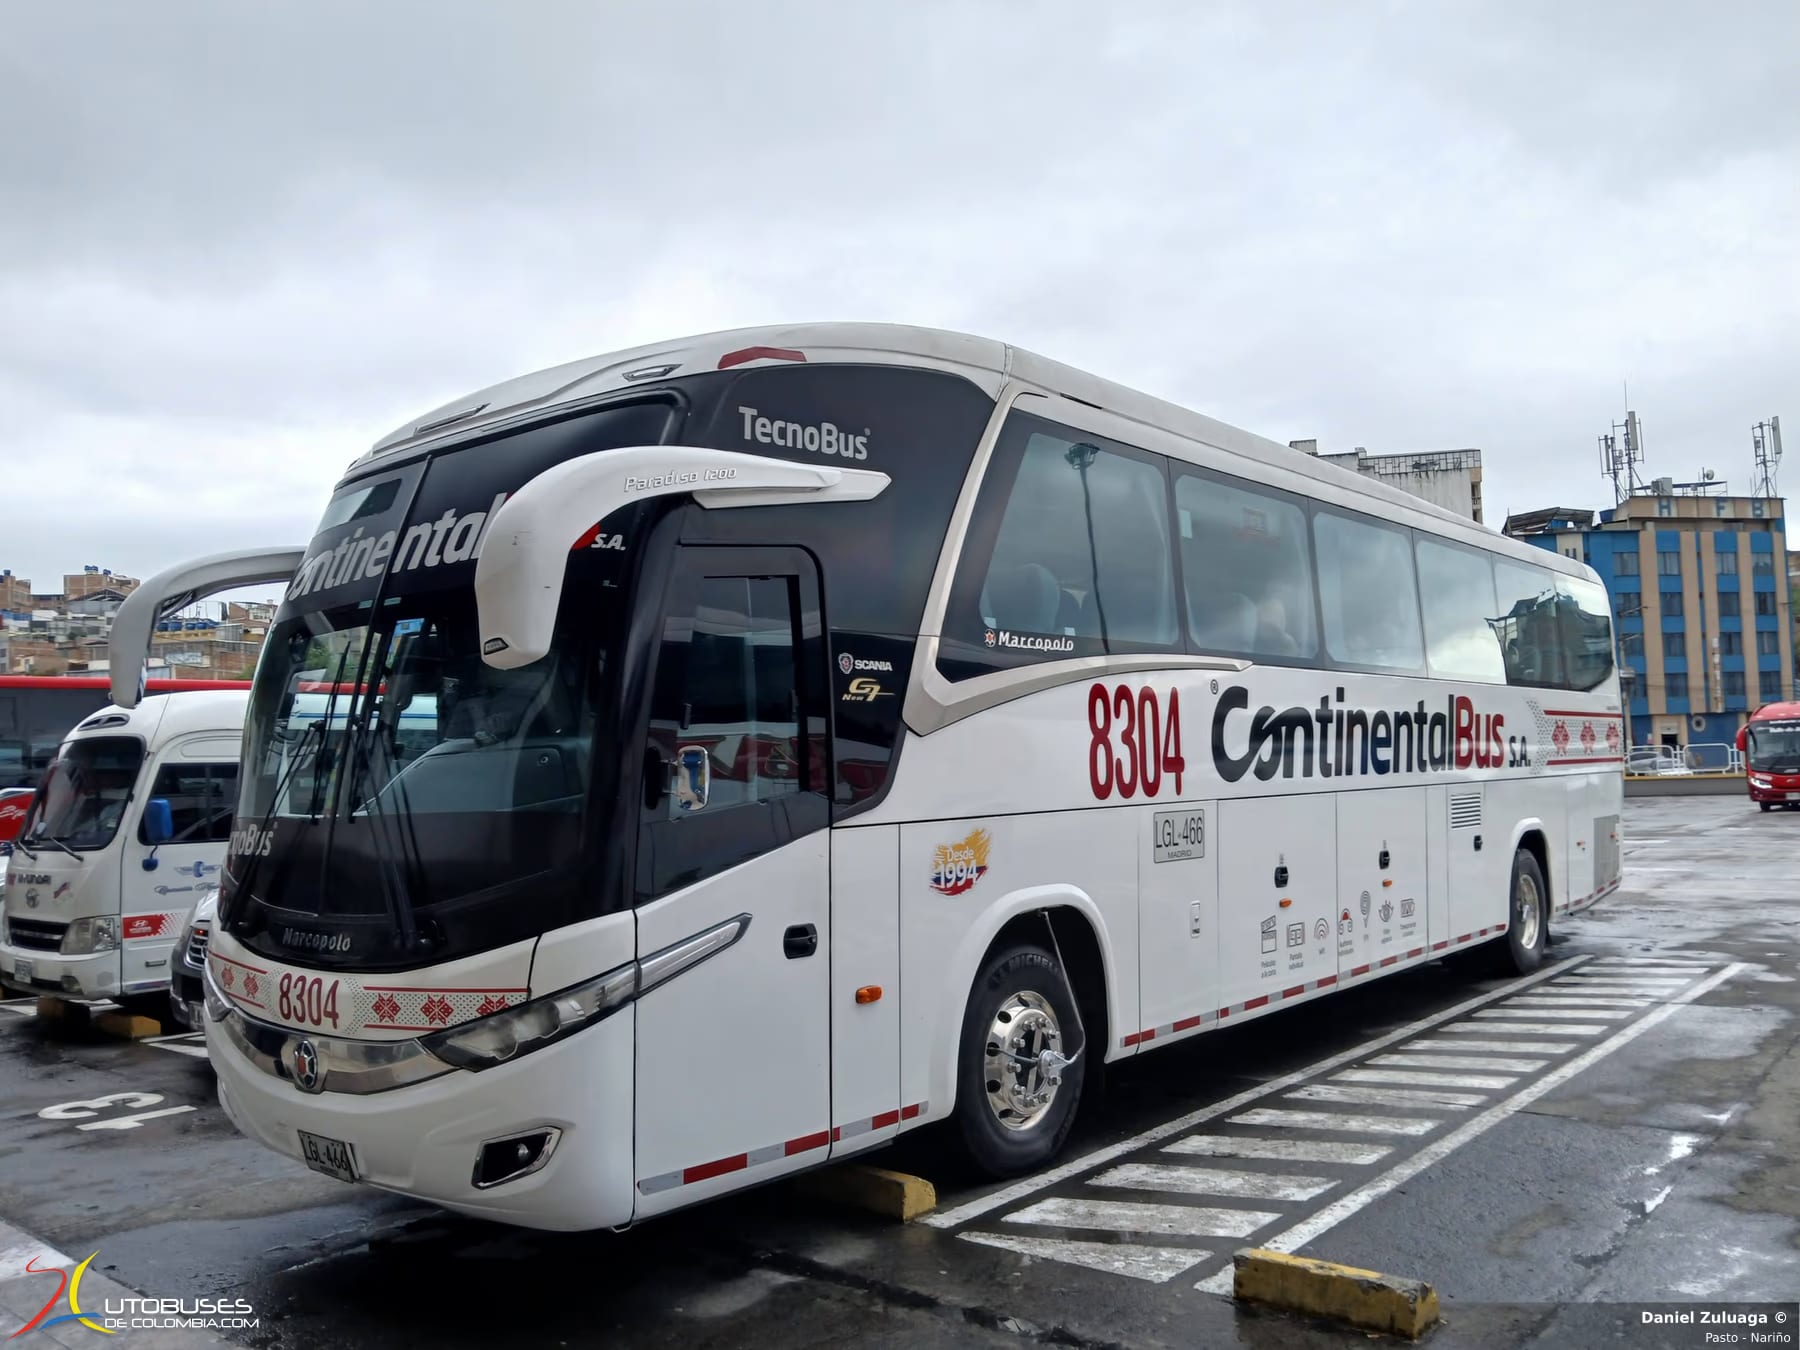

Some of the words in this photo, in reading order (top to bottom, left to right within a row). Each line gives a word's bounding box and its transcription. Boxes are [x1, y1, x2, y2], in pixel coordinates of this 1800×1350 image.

[738, 406, 868, 460] TecnoBus
[624, 471, 697, 492] Paradiso
[704, 467, 737, 480] 1200
[286, 493, 507, 601] ontinental
[591, 533, 626, 550] S.A.
[998, 631, 1074, 651] Marcopolo
[854, 659, 893, 671] SCANIA
[1088, 683, 1185, 800] 8304
[1211, 685, 1504, 782] ContinentalBus
[1509, 736, 1531, 767] S.A.
[946, 846, 975, 861] Desde
[1167, 850, 1192, 859] MADRID
[940, 860, 977, 888] 1994
[283, 928, 350, 952] Marcopolo
[279, 973, 339, 1029] 8304
